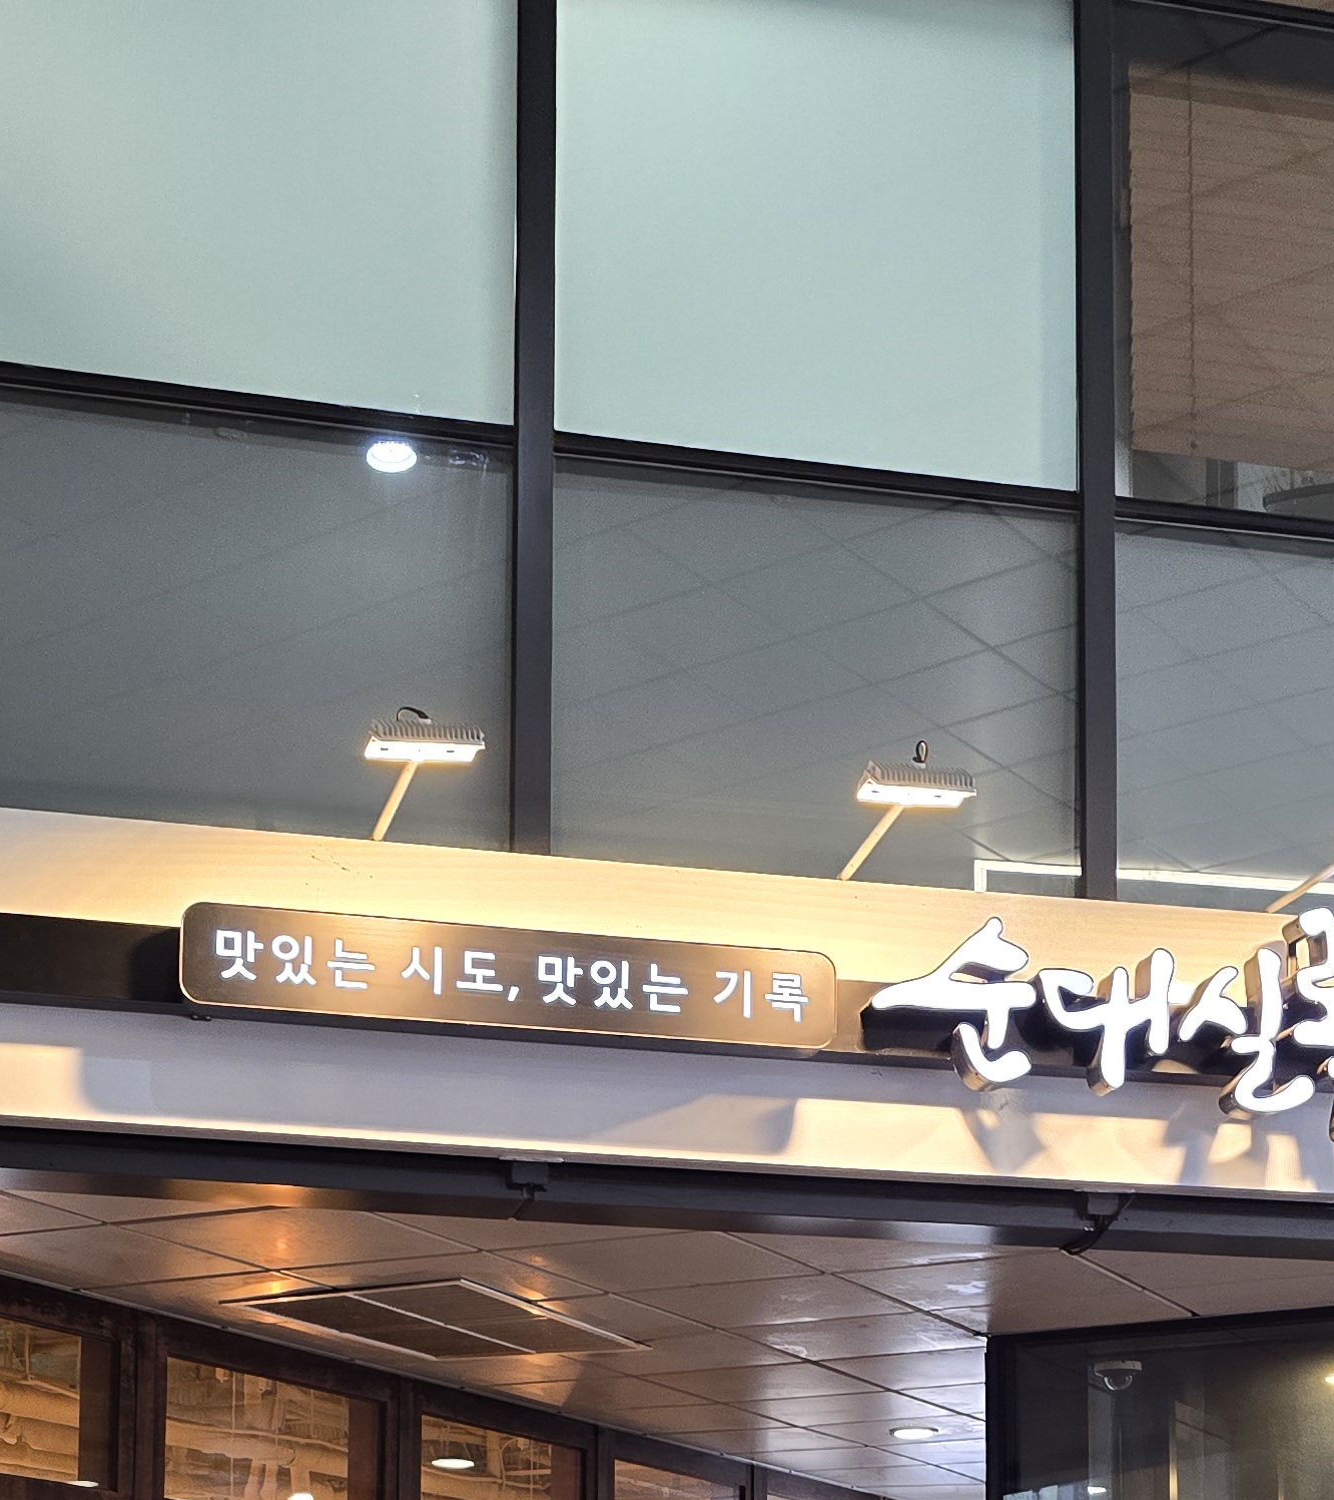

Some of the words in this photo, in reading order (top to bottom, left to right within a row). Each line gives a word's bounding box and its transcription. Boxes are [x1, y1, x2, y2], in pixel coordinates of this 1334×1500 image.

[214, 928, 376, 991] 맛있는
[400, 945, 522, 1003] 시도,
[536, 954, 691, 1014] 맛있는
[711, 968, 811, 1023] 기록
